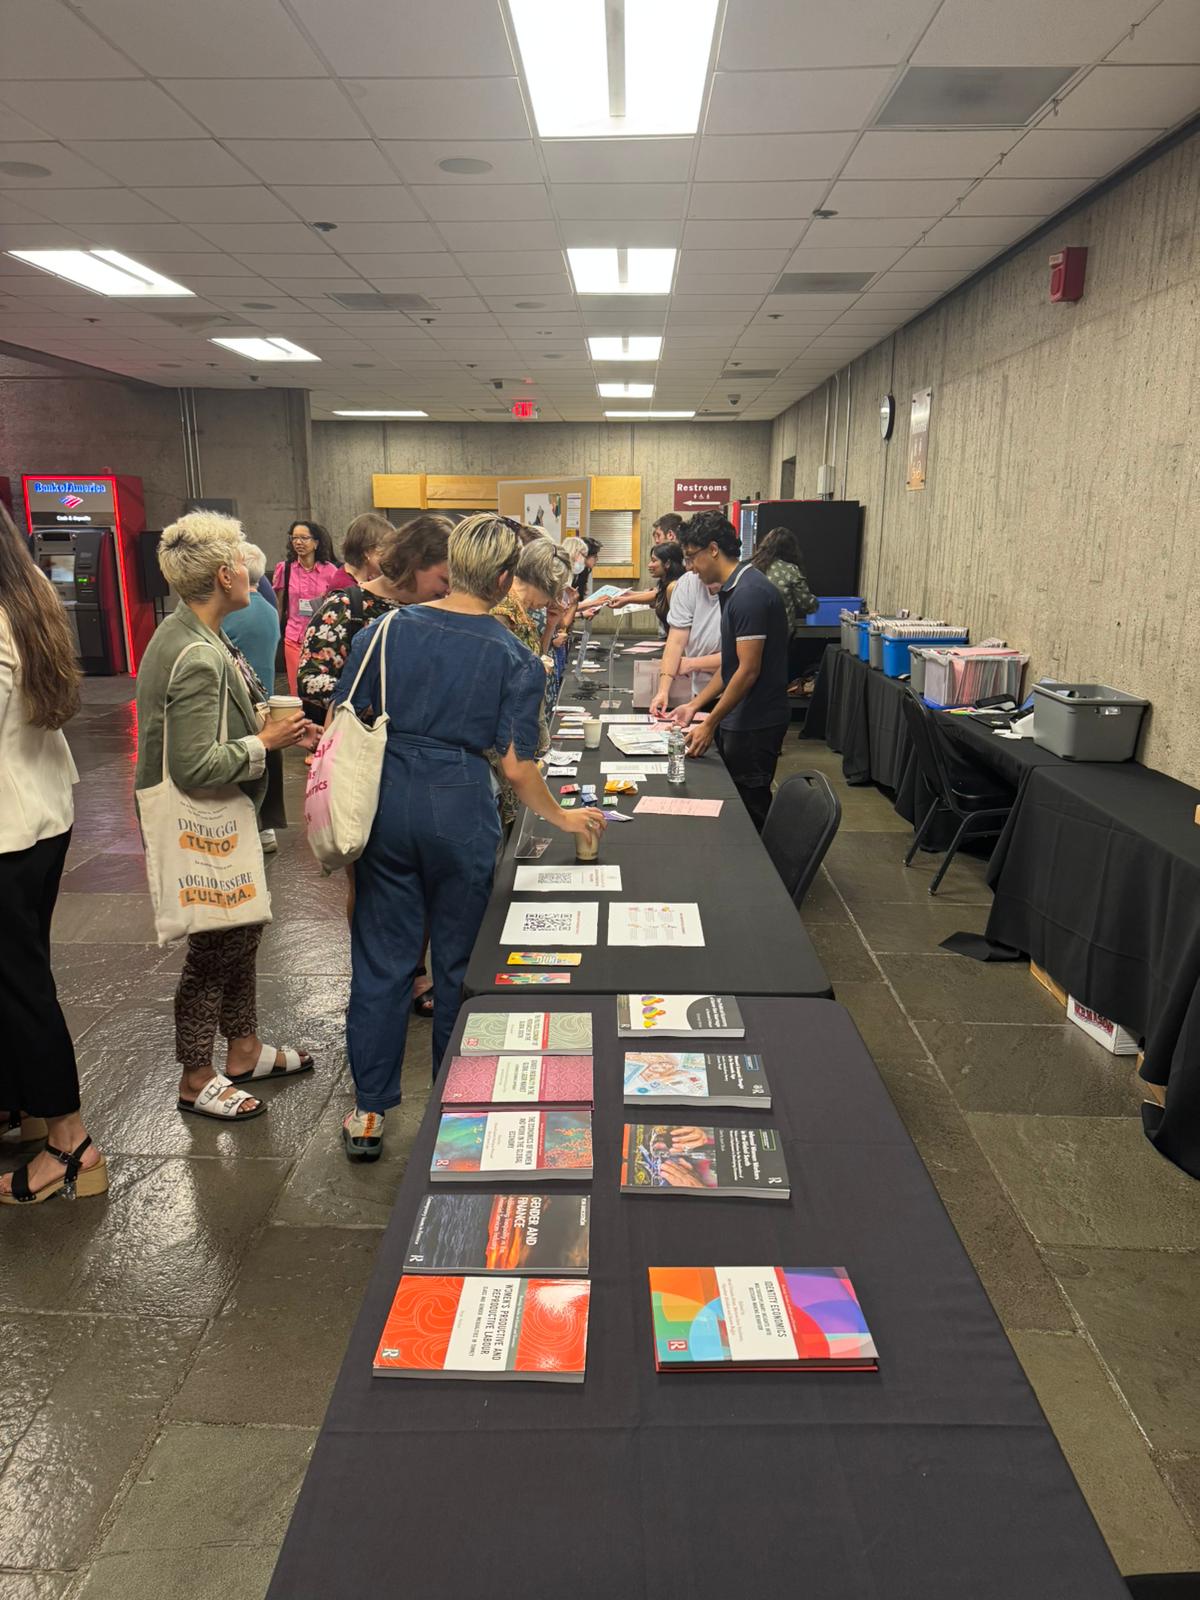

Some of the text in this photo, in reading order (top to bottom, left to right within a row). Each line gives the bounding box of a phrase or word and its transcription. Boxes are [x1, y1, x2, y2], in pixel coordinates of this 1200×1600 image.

[514, 401, 533, 417] EXIT
[34, 481, 107, 493] Bank of America
[676, 483, 728, 492] Restrooms
[513, 1197, 529, 1228] FINANCE
[526, 1197, 541, 1246] GENDER AND
[409, 1254, 424, 1262] R
[764, 1281, 787, 1338] IDENTITY ECONOMICS
[480, 1288, 502, 1355] REPRODUCTIVE LABOUR
[492, 1284, 514, 1361] WOMEN'S PRODUCTIVE AND
[381, 1348, 399, 1358] R
[668, 1342, 687, 1350] R
